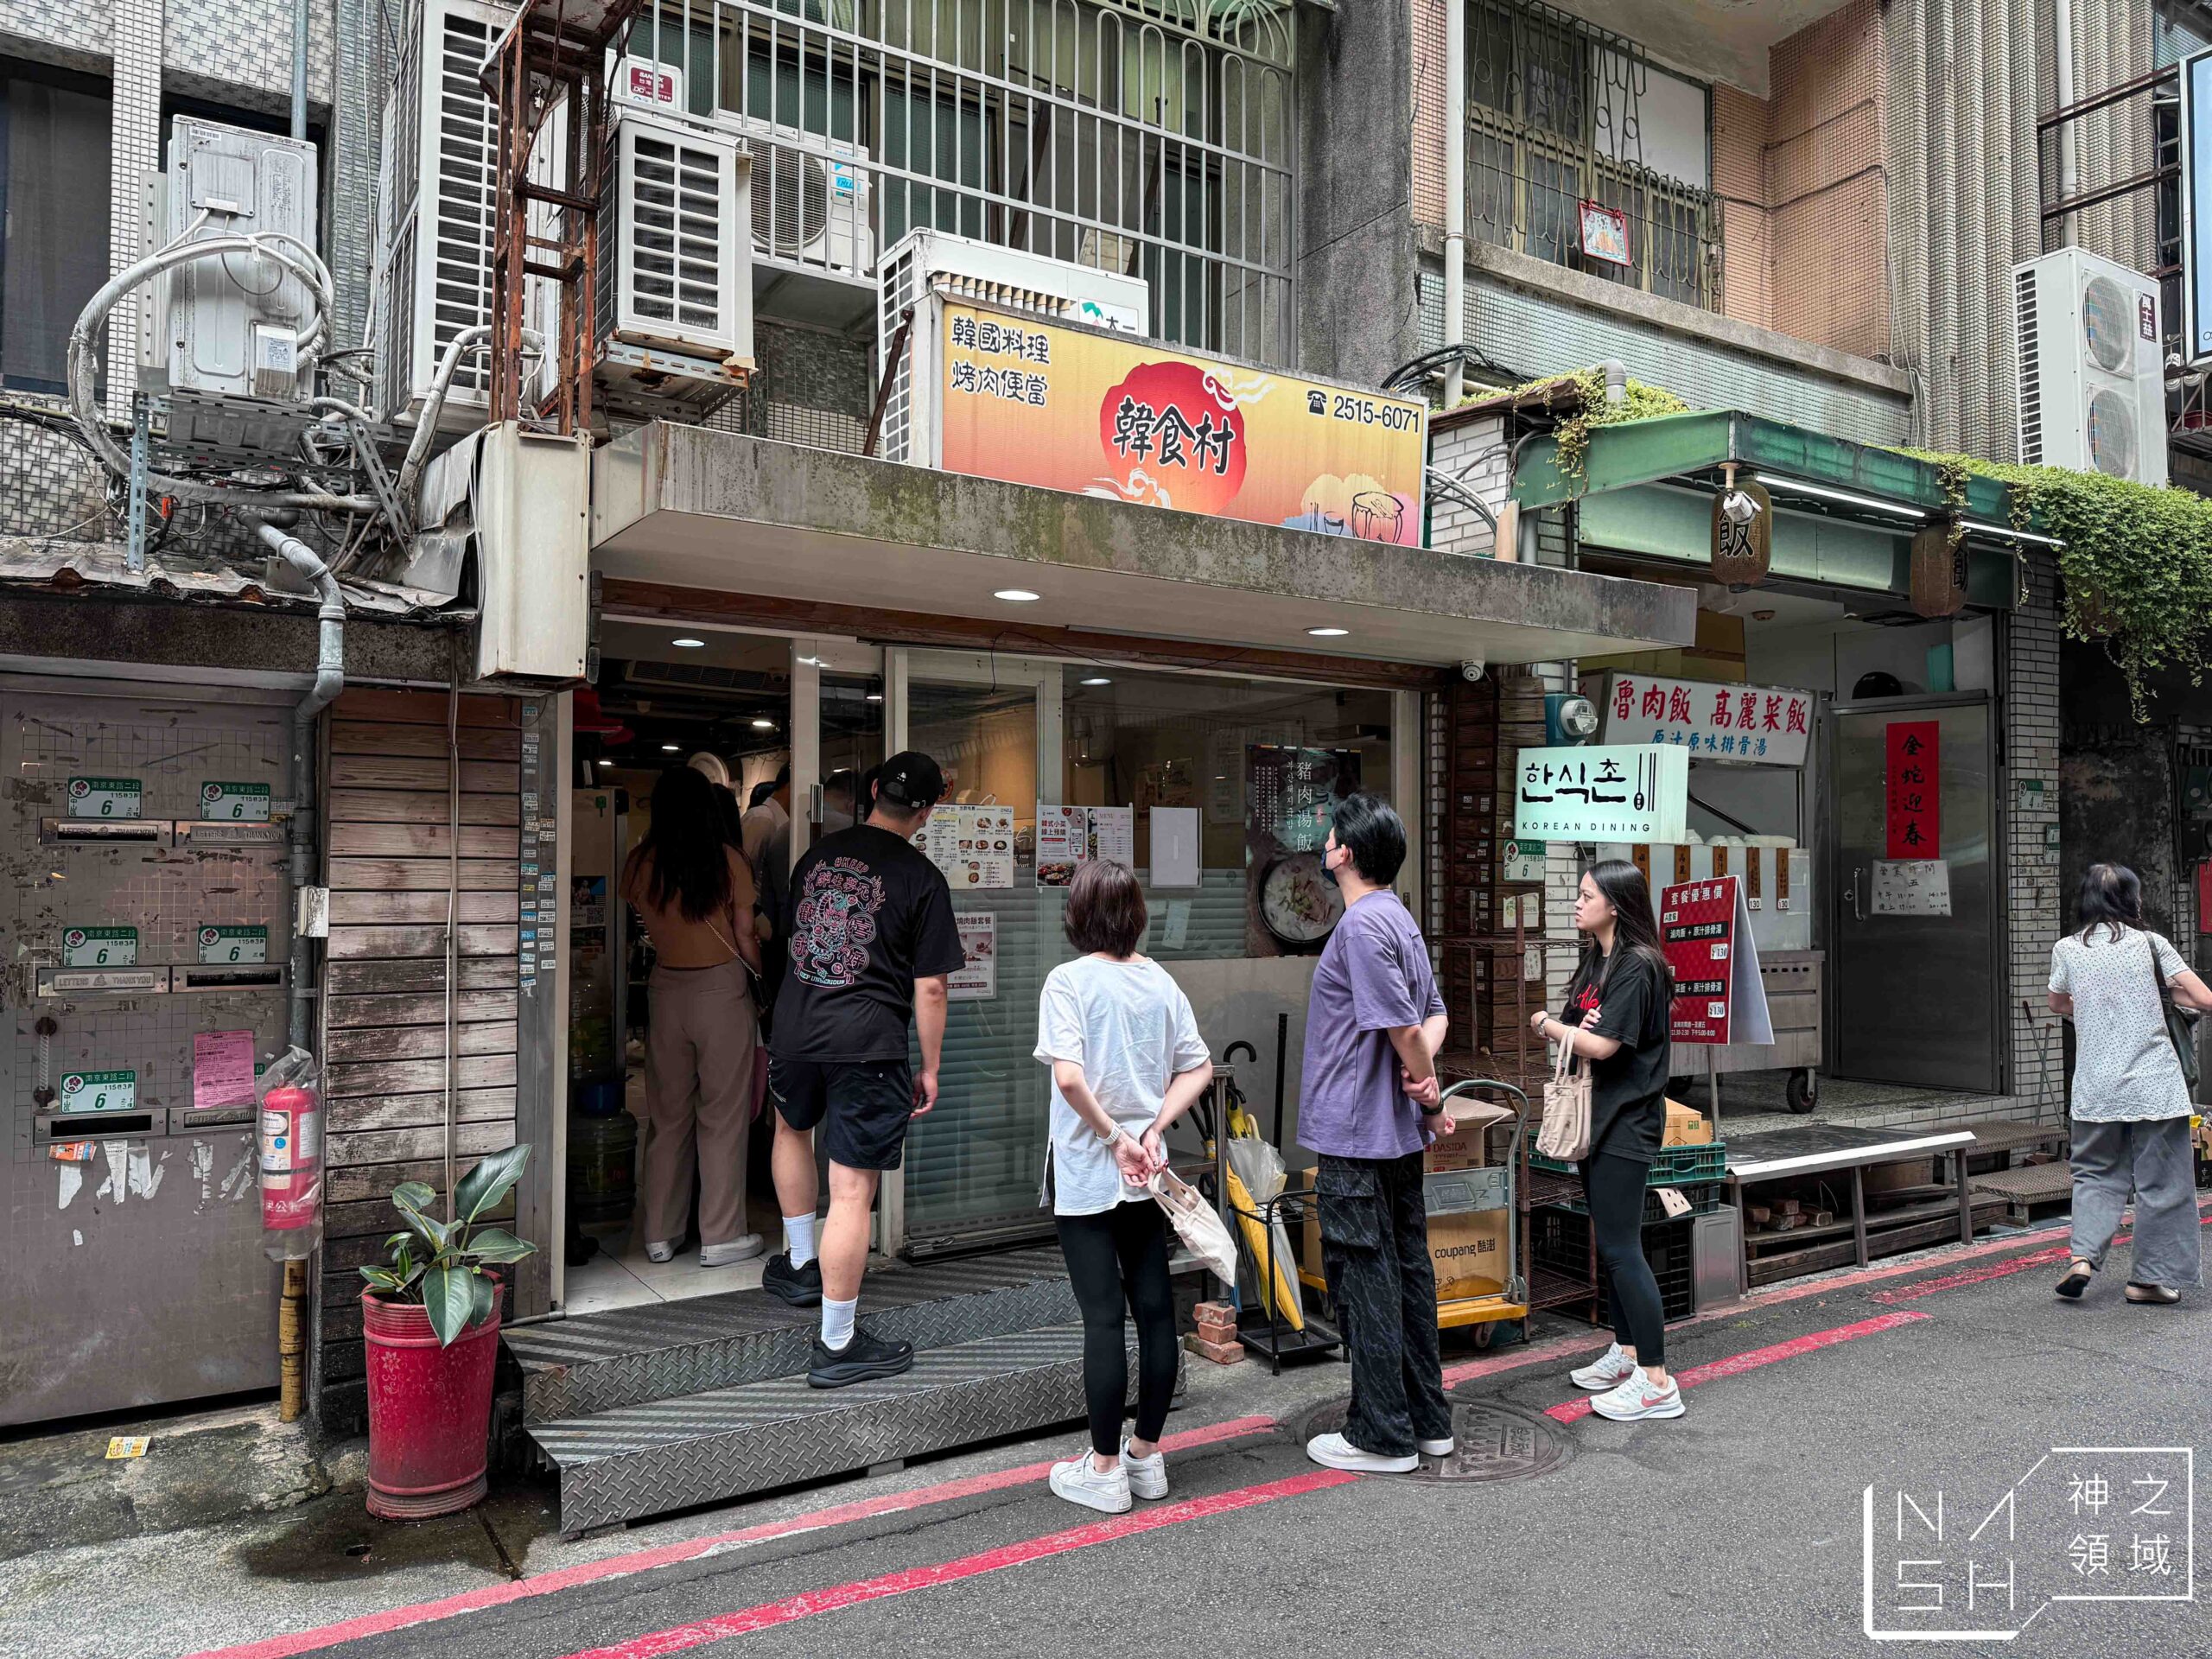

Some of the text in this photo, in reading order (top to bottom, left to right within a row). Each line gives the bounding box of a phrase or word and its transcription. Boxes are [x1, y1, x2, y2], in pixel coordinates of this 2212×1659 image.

[951, 315, 1050, 365] 韓國料理
[951, 361, 1048, 406] 烤肉便當
[1333, 395, 1420, 433] 2515-6071
[1113, 396, 1235, 475] 韓食村
[1718, 506, 1755, 557] 飯
[1613, 679, 1807, 734] 魯肉飯 高麗菜飯
[1651, 729, 1768, 756] 原汁原味排骨湯
[1522, 758, 1627, 804] 한식촌
[1902, 734, 1927, 846] 金蛇迎春
[101, 799, 113, 816] 6
[232, 803, 244, 818] 6
[1297, 761, 1313, 852] 豬肉湯飯
[266, 830, 283, 839] YOU
[1522, 822, 1650, 832] KOREAN DINING
[1522, 865, 1529, 877] 6
[816, 871, 869, 901] 醉生夢死
[1671, 885, 1723, 906] 套餐優惠價
[1749, 900, 1760, 909] 130
[1778, 900, 1789, 909] 130
[1694, 924, 1722, 936] 原汁排骨湯
[97, 948, 109, 964] 6
[229, 946, 241, 962] 6
[58, 975, 152, 987] LETTERS THANK YOU
[1694, 982, 1722, 994] 原汁排骨湯
[95, 1092, 107, 1109] 6
[1433, 1141, 1467, 1153] DASIDA
[1434, 1238, 1496, 1260] coupang 酷澎
